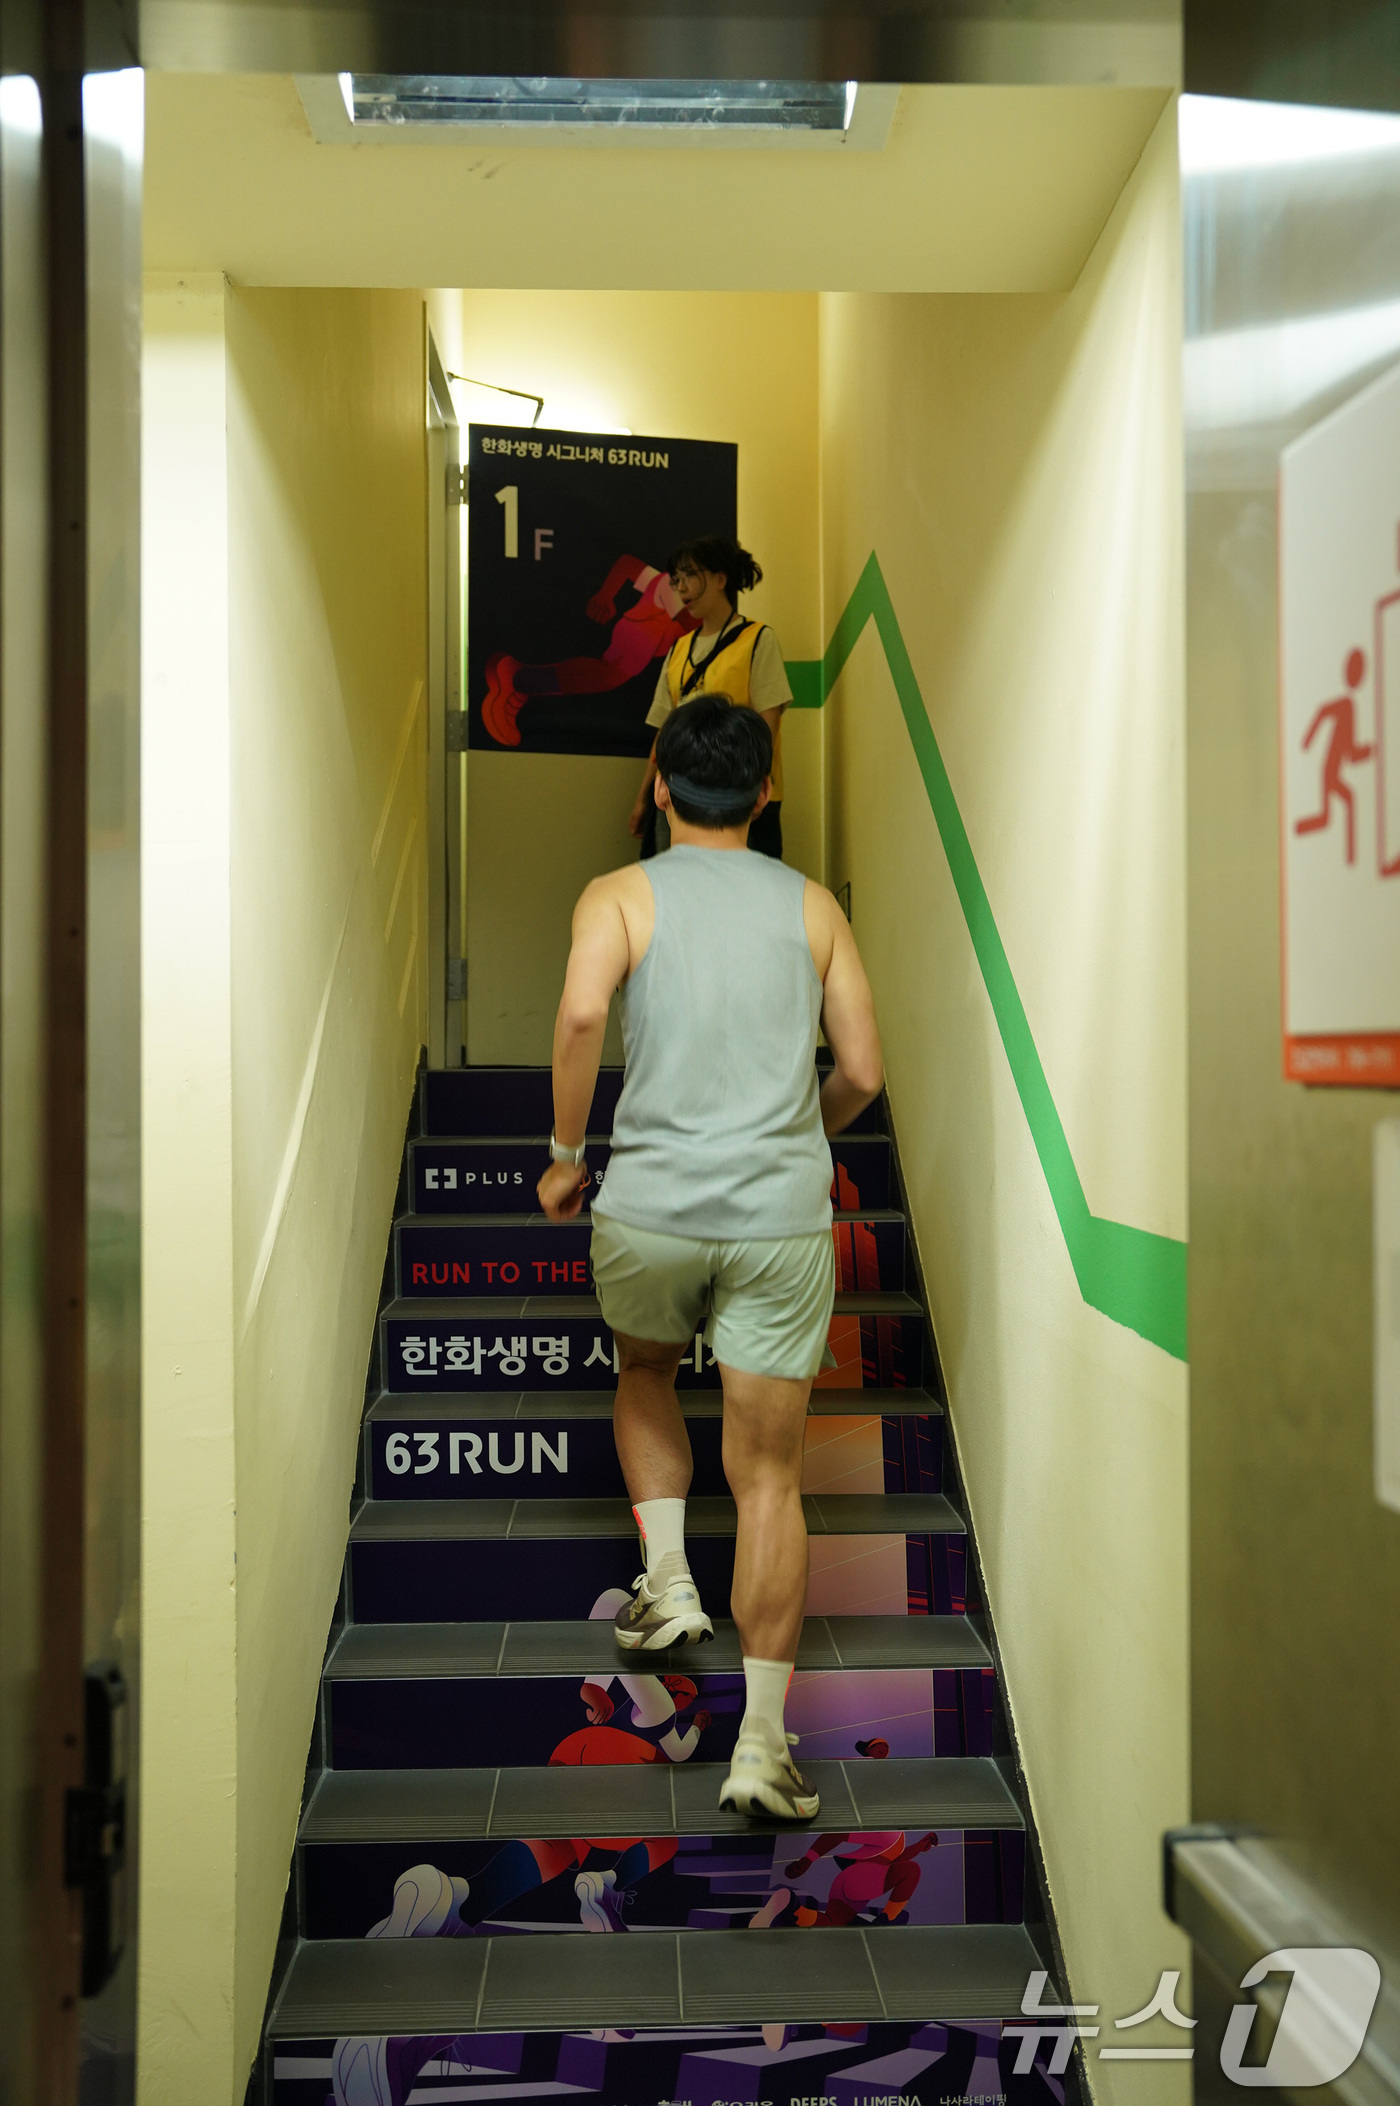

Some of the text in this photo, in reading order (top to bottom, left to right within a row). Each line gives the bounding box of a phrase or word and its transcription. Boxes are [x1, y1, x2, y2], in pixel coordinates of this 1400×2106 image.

[481, 436, 669, 469] 한화생명 시그니처 63RUN
[465, 1171, 524, 1185] PLUS
[412, 1260, 588, 1285] RUN TO THE
[400, 1335, 570, 1376] 한화생명
[384, 1431, 569, 1476] 63RUN
